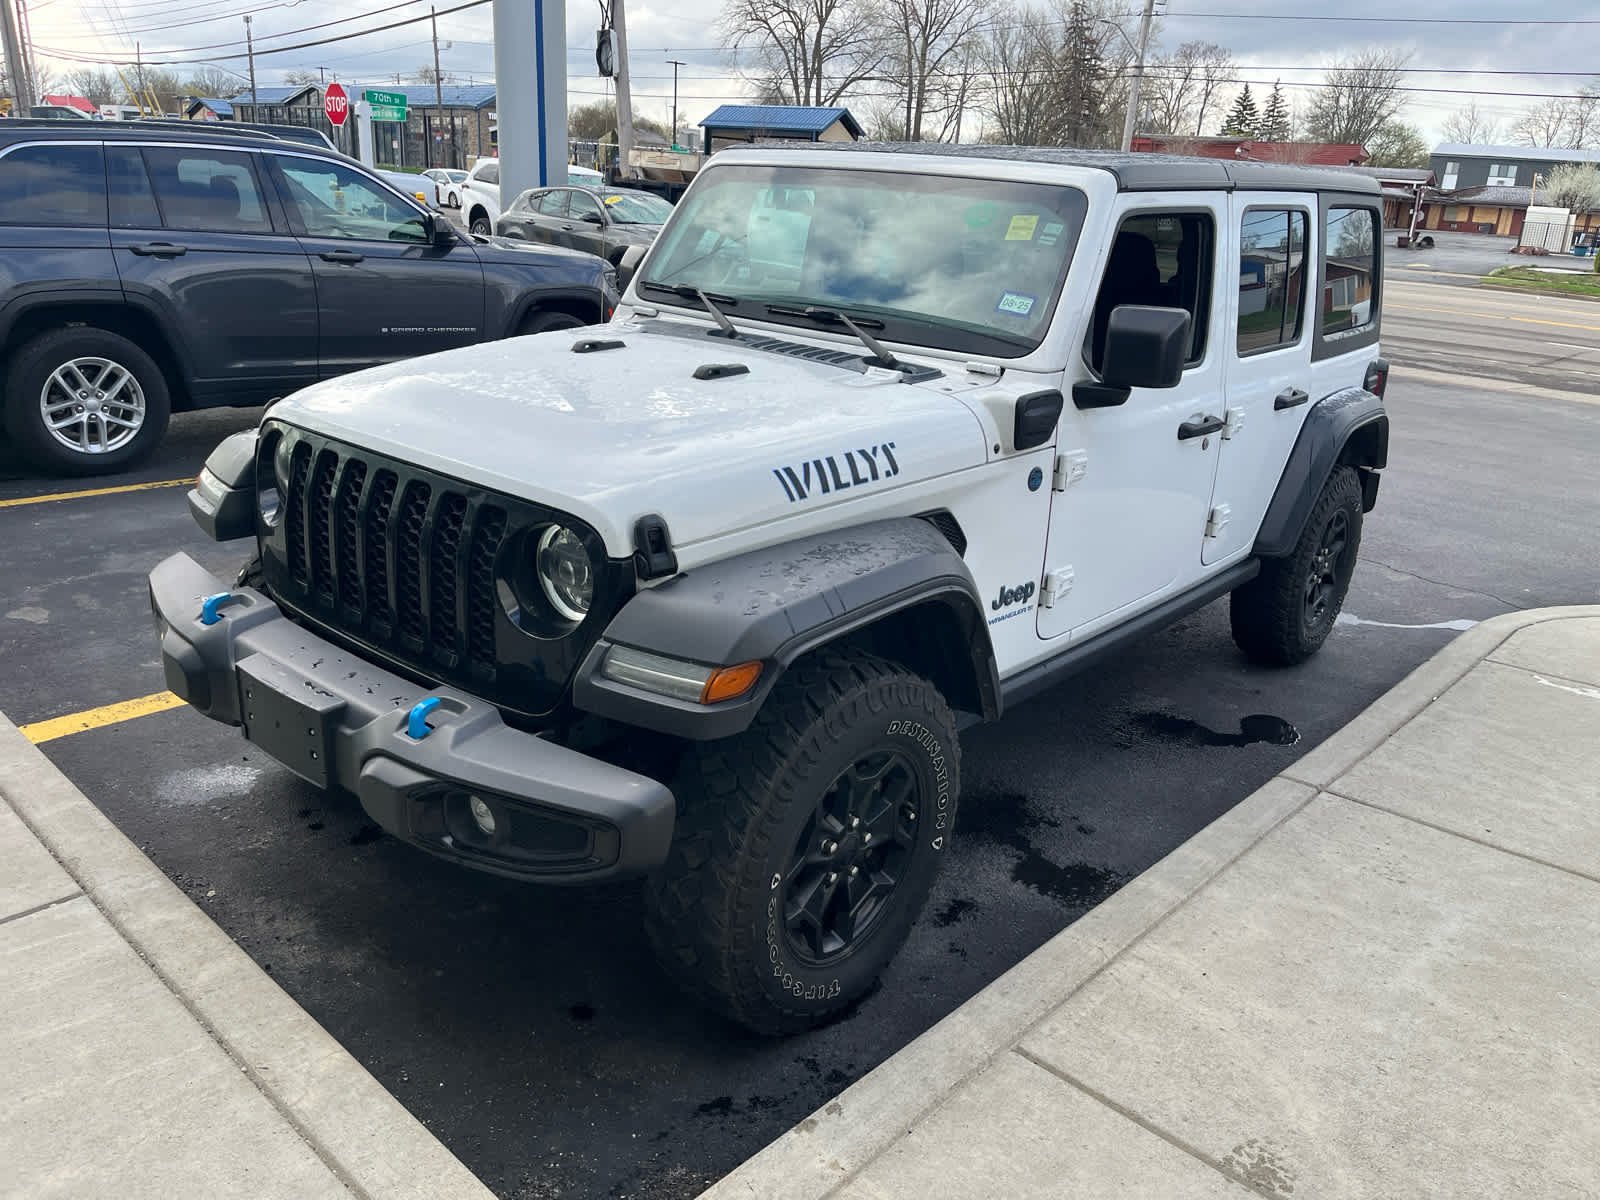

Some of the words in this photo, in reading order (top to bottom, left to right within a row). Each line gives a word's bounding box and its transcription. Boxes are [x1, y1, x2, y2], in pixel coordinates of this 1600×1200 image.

[326, 96, 346, 113] STOP
[373, 92, 392, 103] 70th
[772, 441, 900, 502] WILLYS
[991, 580, 1036, 611] Jeep
[886, 720, 949, 830] DESTINATION
